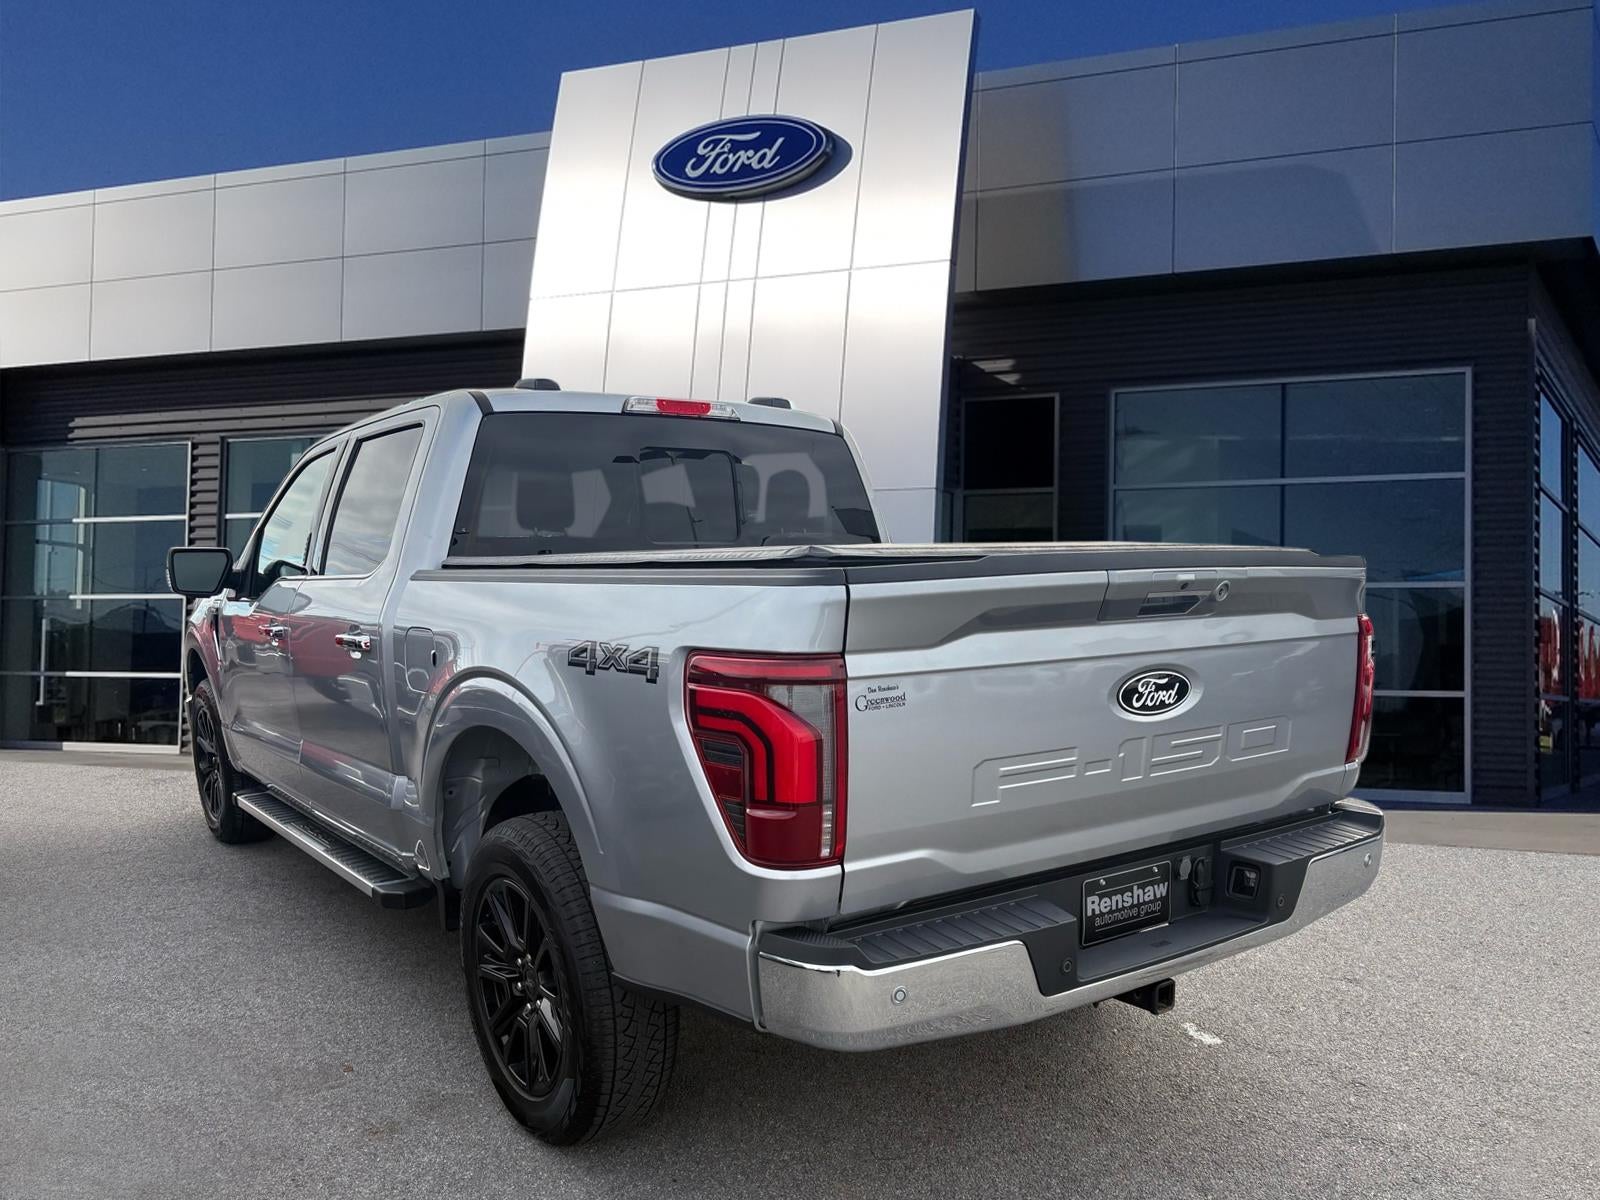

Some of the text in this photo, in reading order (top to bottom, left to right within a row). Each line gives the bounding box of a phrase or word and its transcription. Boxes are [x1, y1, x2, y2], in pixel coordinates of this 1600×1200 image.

[685, 131, 784, 178] Ford
[855, 691, 906, 712] Greenwood
[1132, 678, 1179, 708] Ford
[971, 715, 1293, 807] F-150
[1086, 881, 1168, 916] Renshaw
[1095, 900, 1161, 926] automotive group
